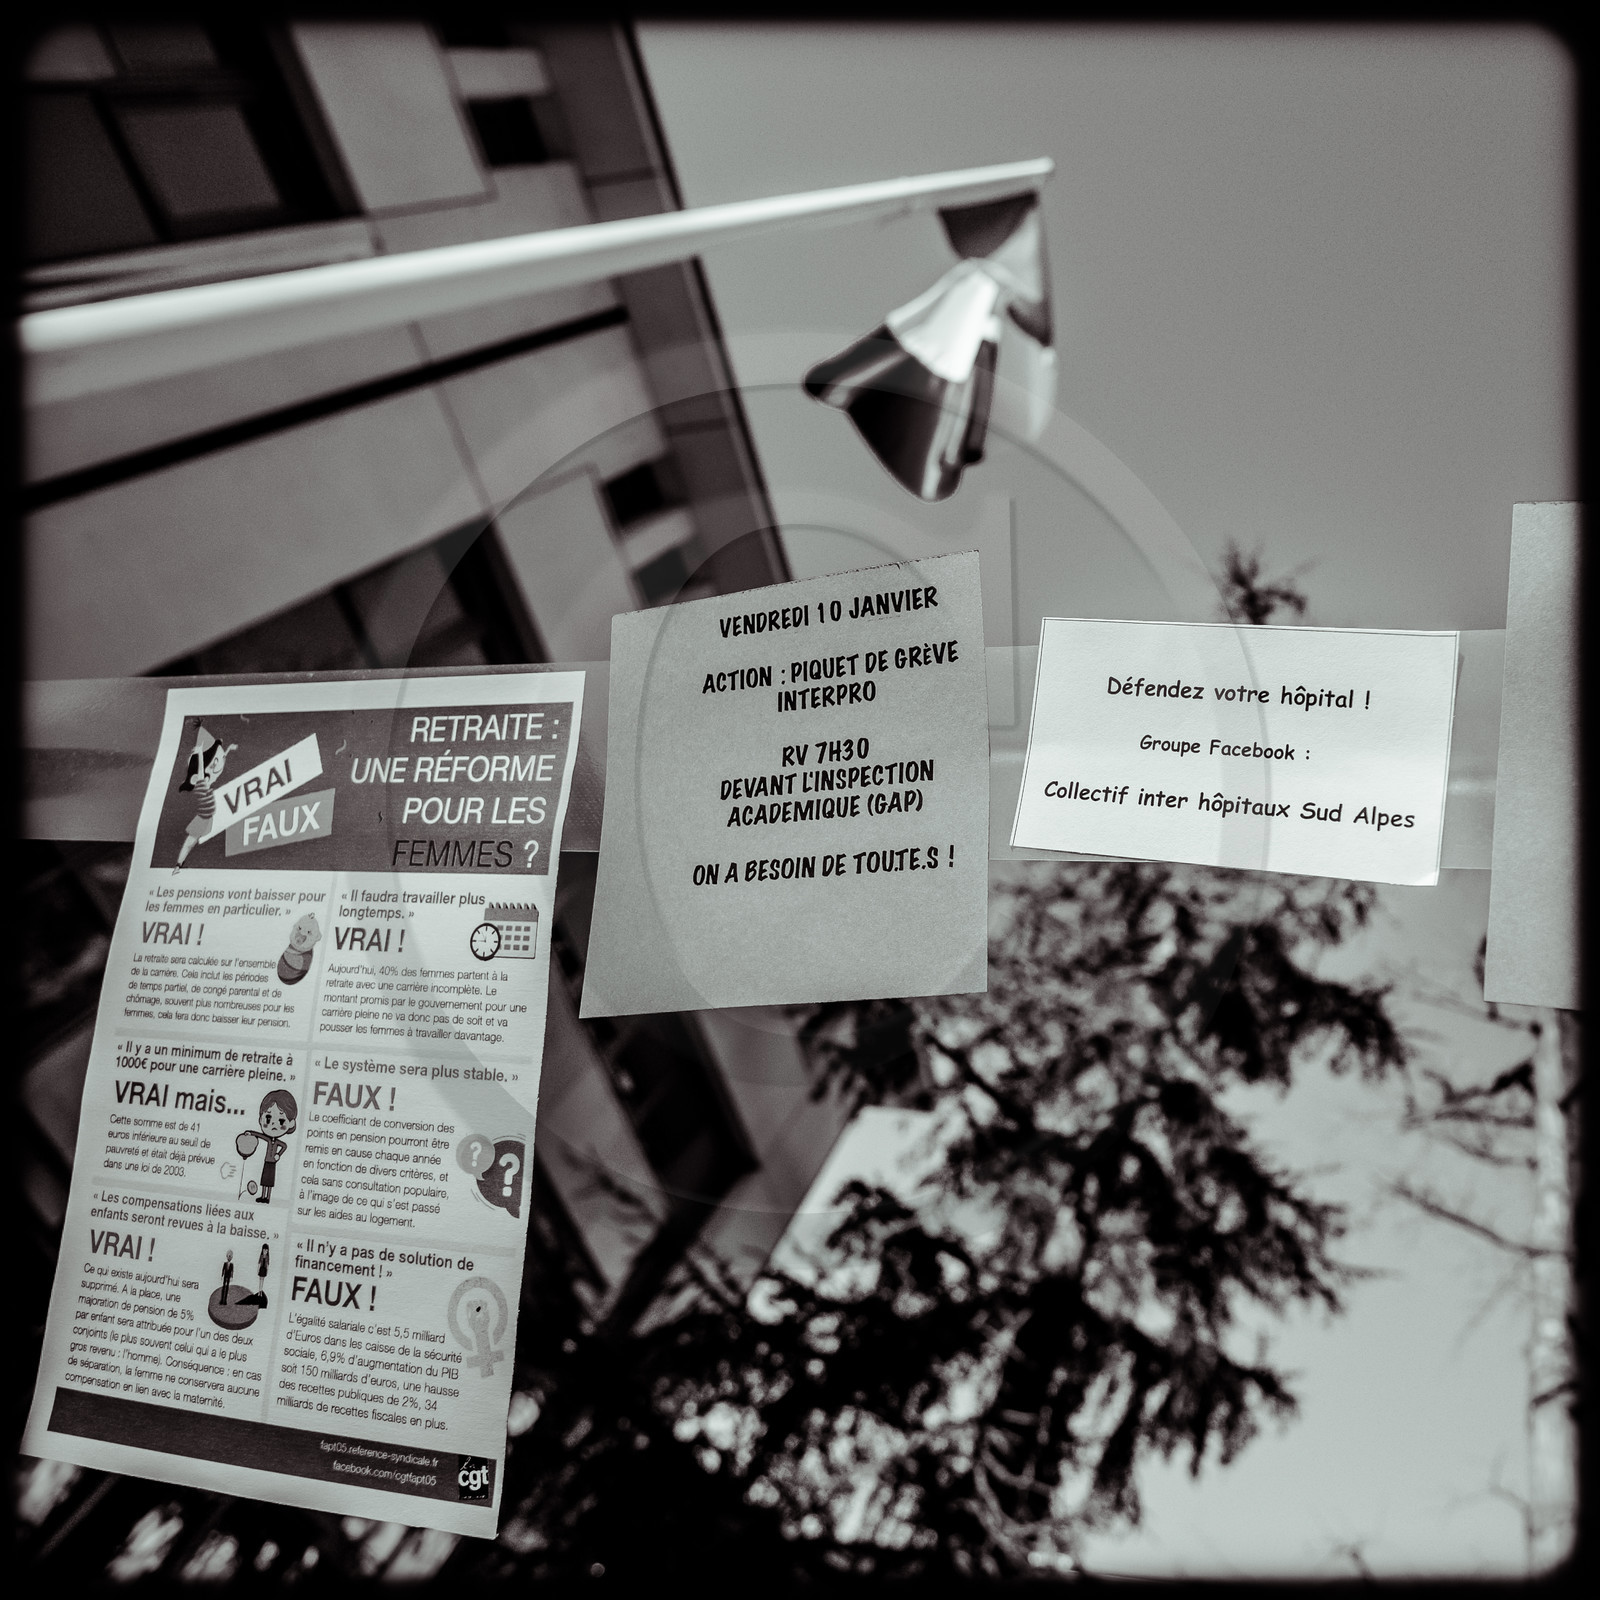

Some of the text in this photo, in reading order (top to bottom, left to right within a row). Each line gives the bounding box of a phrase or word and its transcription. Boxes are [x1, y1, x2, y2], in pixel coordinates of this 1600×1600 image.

[719, 604, 810, 639] VENDREDI
[848, 585, 939, 620] JANVIER
[702, 665, 772, 694] ACTION
[780, 669, 787, 685] :
[790, 653, 859, 683] PIQUET
[865, 649, 890, 673] DE
[777, 680, 877, 713] INTERPRO
[1107, 676, 1371, 711] Défendez votre hôpital !
[410, 712, 559, 743] RETRAITE :
[781, 737, 870, 767] RV 7H30
[1140, 734, 1310, 761] Groupe Facebook :
[351, 750, 556, 784] UNE RÉFORME
[720, 758, 935, 801] DEVANT L'INSPECTION
[224, 758, 293, 814] VRAI
[402, 796, 547, 825] POUR LES
[727, 789, 924, 828] ACADEMIQUE (GAP)
[1044, 781, 1416, 832] Collectif inter hôpitaux Sud Alpes
[242, 802, 321, 846] FAUX
[392, 840, 539, 868] FEMMES ?
[692, 863, 719, 886] ON
[724, 862, 739, 883] A
[744, 855, 816, 883] BESOIN
[822, 853, 847, 876] DE
[948, 844, 955, 868] !
[145, 900, 161, 913] les
[162, 901, 204, 914] femmes
[207, 904, 221, 915] en
[222, 903, 282, 917] particulier.
[156, 886, 175, 898] Les
[176, 887, 225, 901] pensions
[228, 888, 252, 900] vont
[254, 887, 296, 902] baisser
[298, 892, 326, 904] pour
[350, 889, 359, 901] Il
[361, 889, 399, 903] faudra
[402, 890, 456, 904] travailler
[459, 892, 485, 908] plus
[339, 905, 405, 920] longtemps.
[142, 921, 204, 946] VRAI !
[335, 927, 405, 953] VRAI !
[133, 952, 276, 970] La retraite sera calculée sur l'ensemble
[328, 963, 508, 982] Aujourd'hui, 40% des femmes partent à la
[126, 1040, 133, 1053] Il
[135, 1044, 142, 1056] y
[145, 1044, 151, 1054] a
[154, 1045, 168, 1056] un
[171, 1044, 221, 1060] minimum
[224, 1049, 239, 1061] de
[241, 1051, 283, 1065] retraite
[286, 1053, 293, 1066] à
[116, 1056, 148, 1070] 1000€
[150, 1060, 176, 1073] pour
[179, 1062, 199, 1073] une
[202, 1063, 246, 1078] carrière
[248, 1067, 286, 1082] pleine.
[324, 1056, 339, 1070] Le
[342, 1059, 396, 1074] système
[399, 1065, 428, 1076] sera
[431, 1065, 460, 1080] plus
[463, 1065, 508, 1082] stable.
[115, 1080, 245, 1116] VRAI mais...
[313, 1081, 396, 1112] FAUX !
[109, 1113, 200, 1132] Cette somme est de 41
[309, 1111, 320, 1122] Le
[369, 1117, 382, 1128] de
[383, 1119, 435, 1132] conversion
[437, 1122, 455, 1133] des
[101, 1190, 120, 1204] Les
[122, 1194, 203, 1215] compensations
[205, 1201, 231, 1217] liées
[234, 1209, 255, 1221] aux
[90, 1206, 129, 1221] enfants
[131, 1213, 165, 1227] seront
[167, 1217, 204, 1232] revues
[206, 1219, 214, 1233] à
[216, 1221, 226, 1235] la
[230, 1224, 270, 1240] baisse.
[90, 1229, 156, 1262] VRAI !
[307, 1238, 315, 1252] Il
[317, 1240, 336, 1257] n'y
[340, 1245, 347, 1256] a
[351, 1246, 375, 1261] pas
[379, 1247, 395, 1262] de
[398, 1250, 453, 1269] solution
[457, 1257, 475, 1271] de
[295, 1255, 376, 1277] financement
[378, 1264, 383, 1278] !
[291, 1275, 377, 1312] FAUX !
[288, 1312, 446, 1344] L'égalité salariale c'est 5,5 milliard
[458, 1465, 489, 1491] cgt
